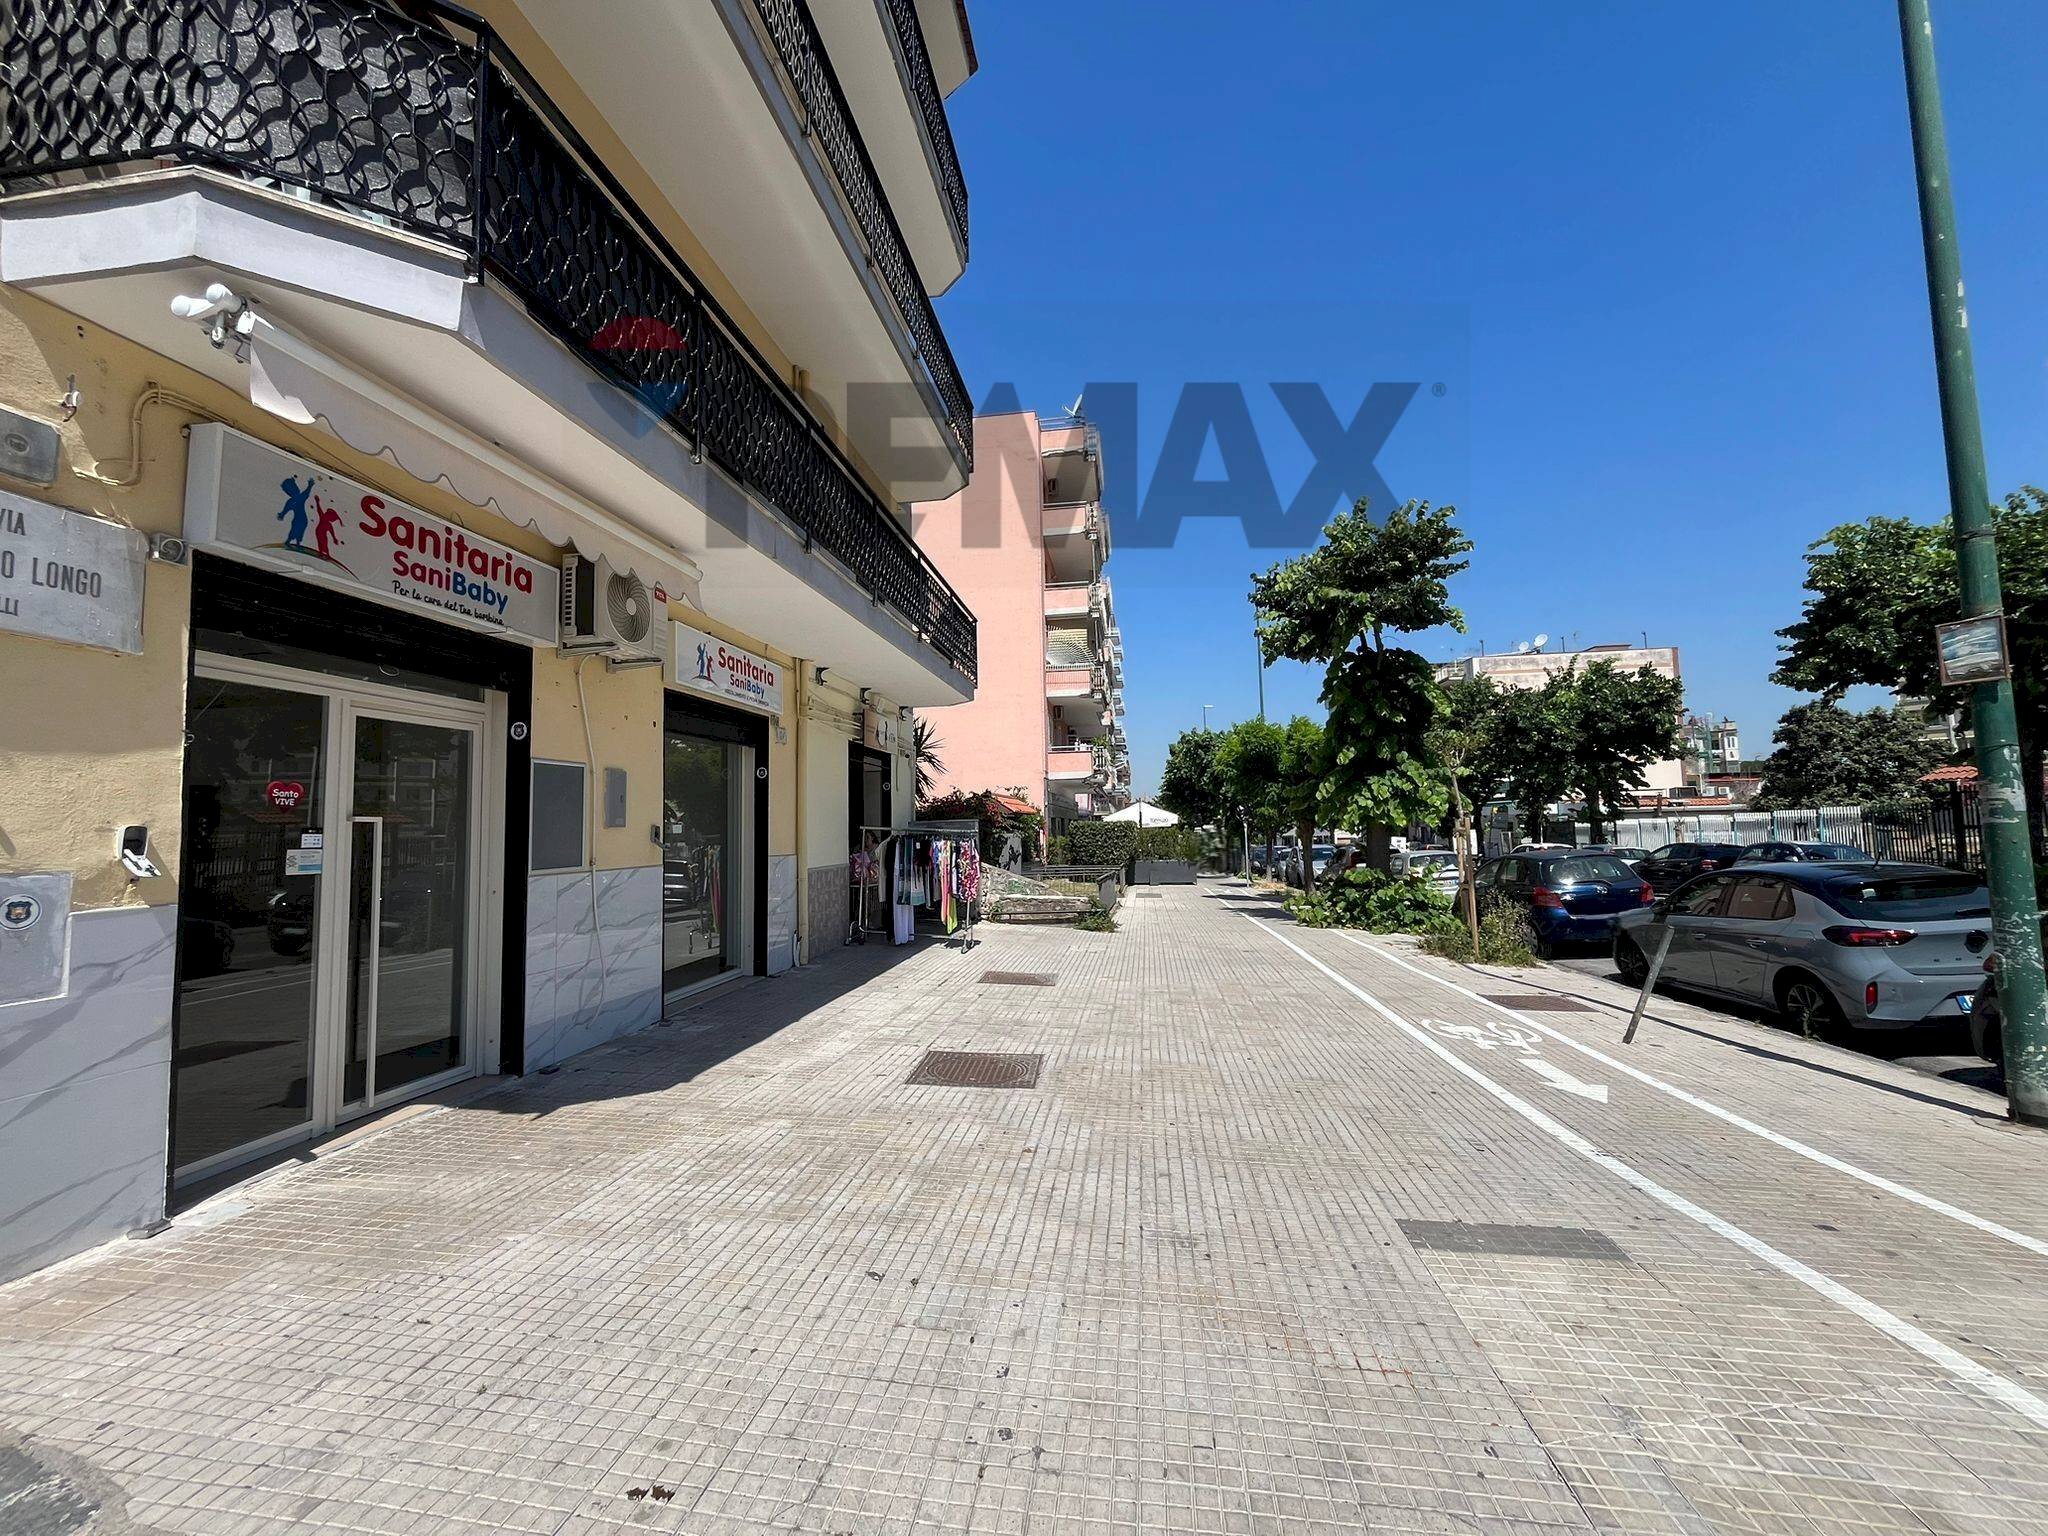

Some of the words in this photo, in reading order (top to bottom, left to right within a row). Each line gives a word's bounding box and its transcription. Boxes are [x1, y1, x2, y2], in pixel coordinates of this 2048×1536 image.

[359, 495, 532, 594] Sanitaria
[32, 557, 102, 598] LONGO
[392, 551, 508, 615] SaniBaby
[392, 580, 410, 596] Per
[412, 588, 423, 600] la
[718, 646, 774, 687] Sanitaria
[730, 674, 765, 699] SaniBaby
[272, 788, 299, 798] Santo
[275, 798, 295, 806] VIVE
